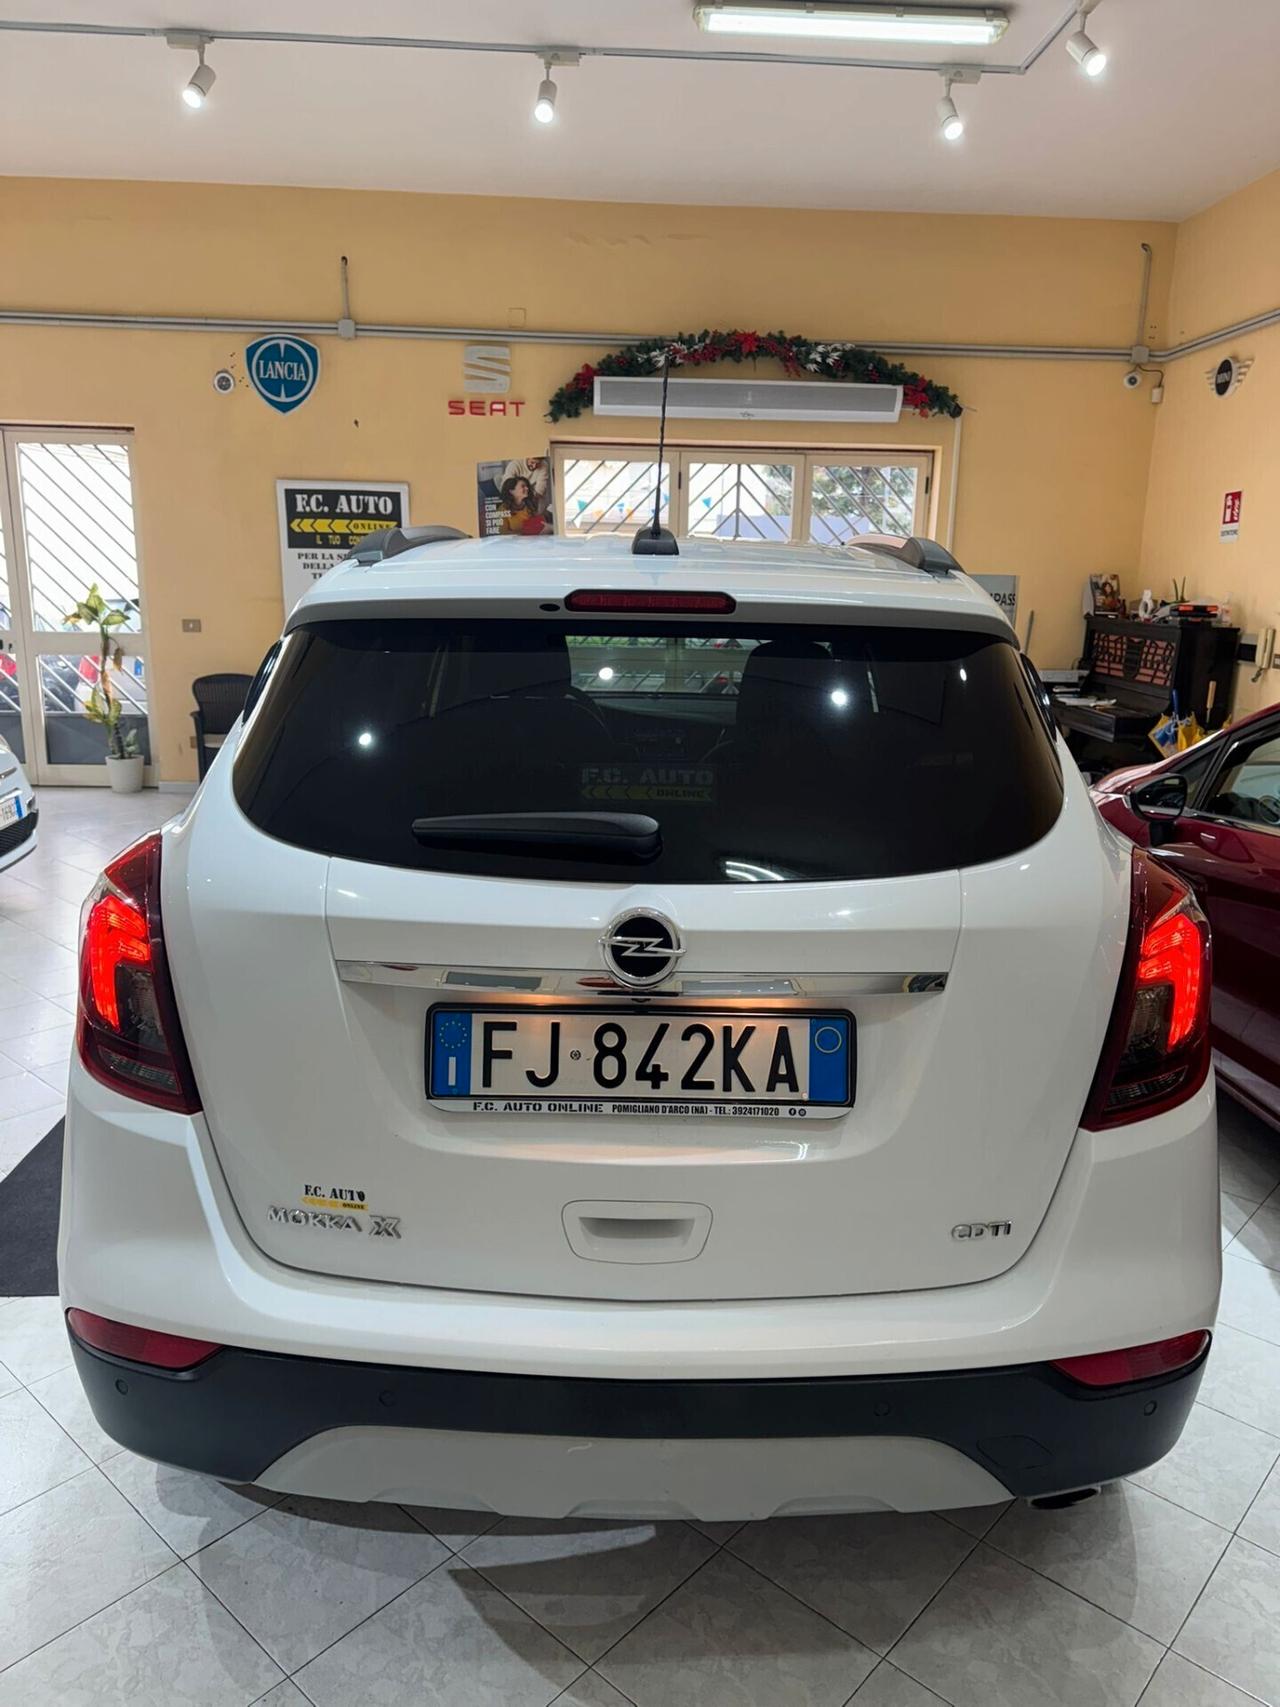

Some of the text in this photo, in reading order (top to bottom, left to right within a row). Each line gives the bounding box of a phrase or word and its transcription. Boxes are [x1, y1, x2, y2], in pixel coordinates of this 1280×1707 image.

[259, 359, 307, 381] LANCIA
[448, 399, 526, 417] SEAT
[295, 493, 393, 515] F.C. AUTO
[297, 552, 319, 560] PER
[473, 1102, 604, 1113] F.C. AUTO ONLINE
[611, 1103, 660, 1114] POMIGLIANO
[661, 1104, 690, 1115] D'ARCO
[732, 1106, 780, 1117] 3924171020
[304, 1184, 366, 1202] F.C. AUTO
[342, 1202, 365, 1210] ONLINE
[267, 1205, 363, 1233] MOKKA
